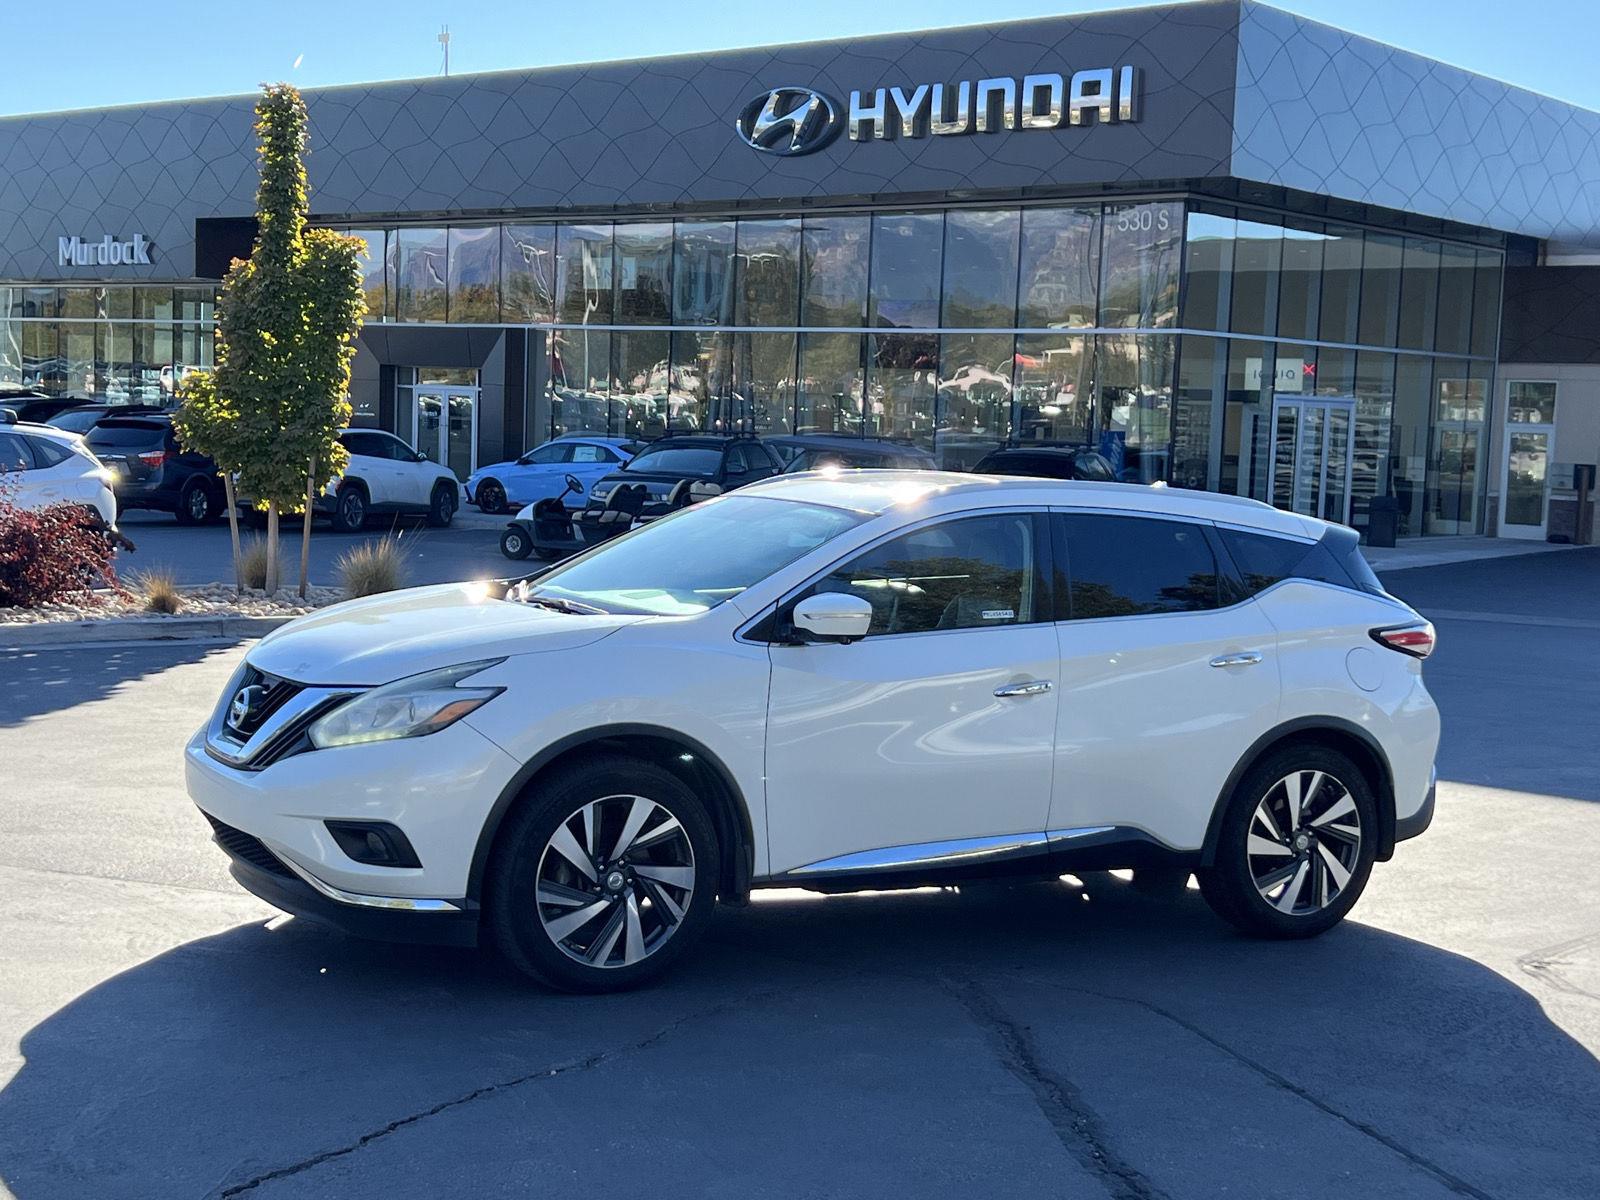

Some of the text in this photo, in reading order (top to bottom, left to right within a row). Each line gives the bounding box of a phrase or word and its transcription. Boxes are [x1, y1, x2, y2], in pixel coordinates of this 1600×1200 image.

[849, 65, 1135, 141] HYUNDAI
[1117, 209, 1169, 231] 530 S
[58, 233, 151, 266] Murdock
[1253, 369, 1296, 380] IIQ
